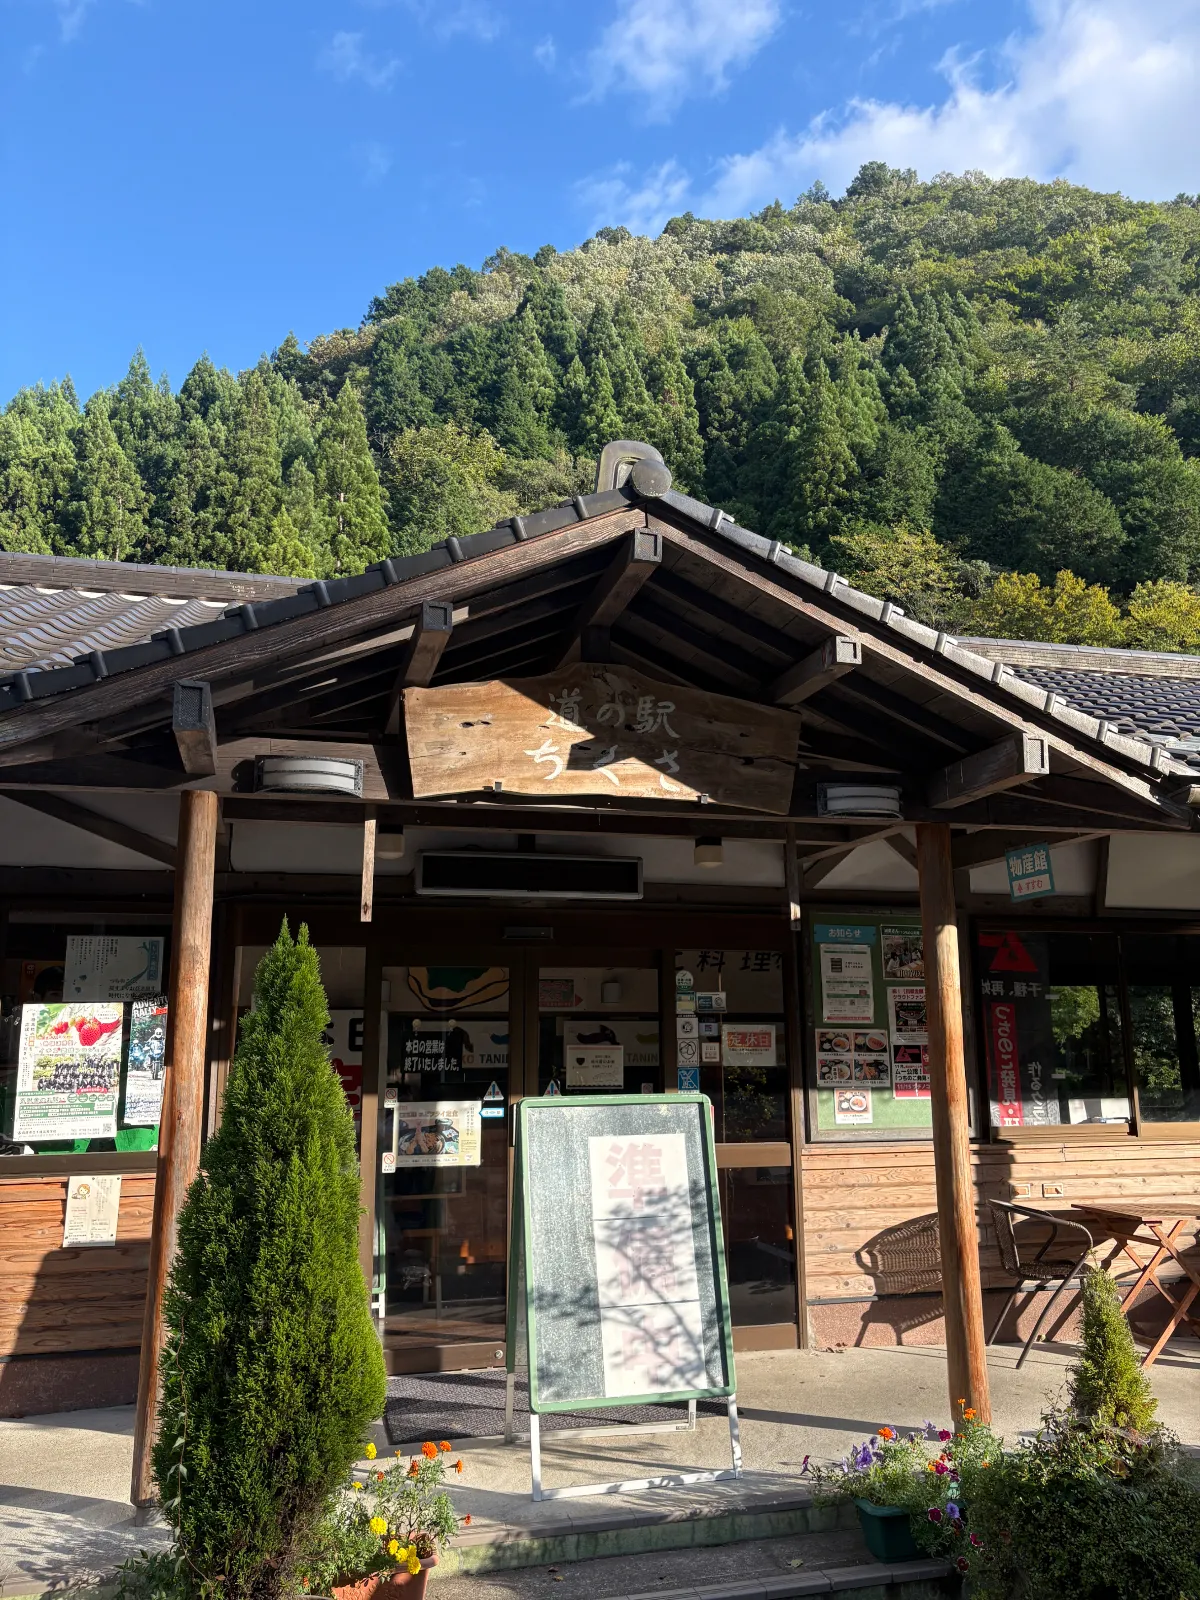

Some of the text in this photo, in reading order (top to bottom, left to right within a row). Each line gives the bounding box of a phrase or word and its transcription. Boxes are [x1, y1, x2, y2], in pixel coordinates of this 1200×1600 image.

[545, 688, 681, 739] 道の駅
[523, 738, 681, 792] ちくさ
[1008, 850, 1048, 877] 物産館
[828, 928, 862, 938] お知らせ
[133, 1006, 157, 1018] RALLY
[405, 1039, 445, 1055] 本日の営業は
[728, 1032, 769, 1047] 定休日
[403, 1056, 459, 1072] 終了いたしました。
